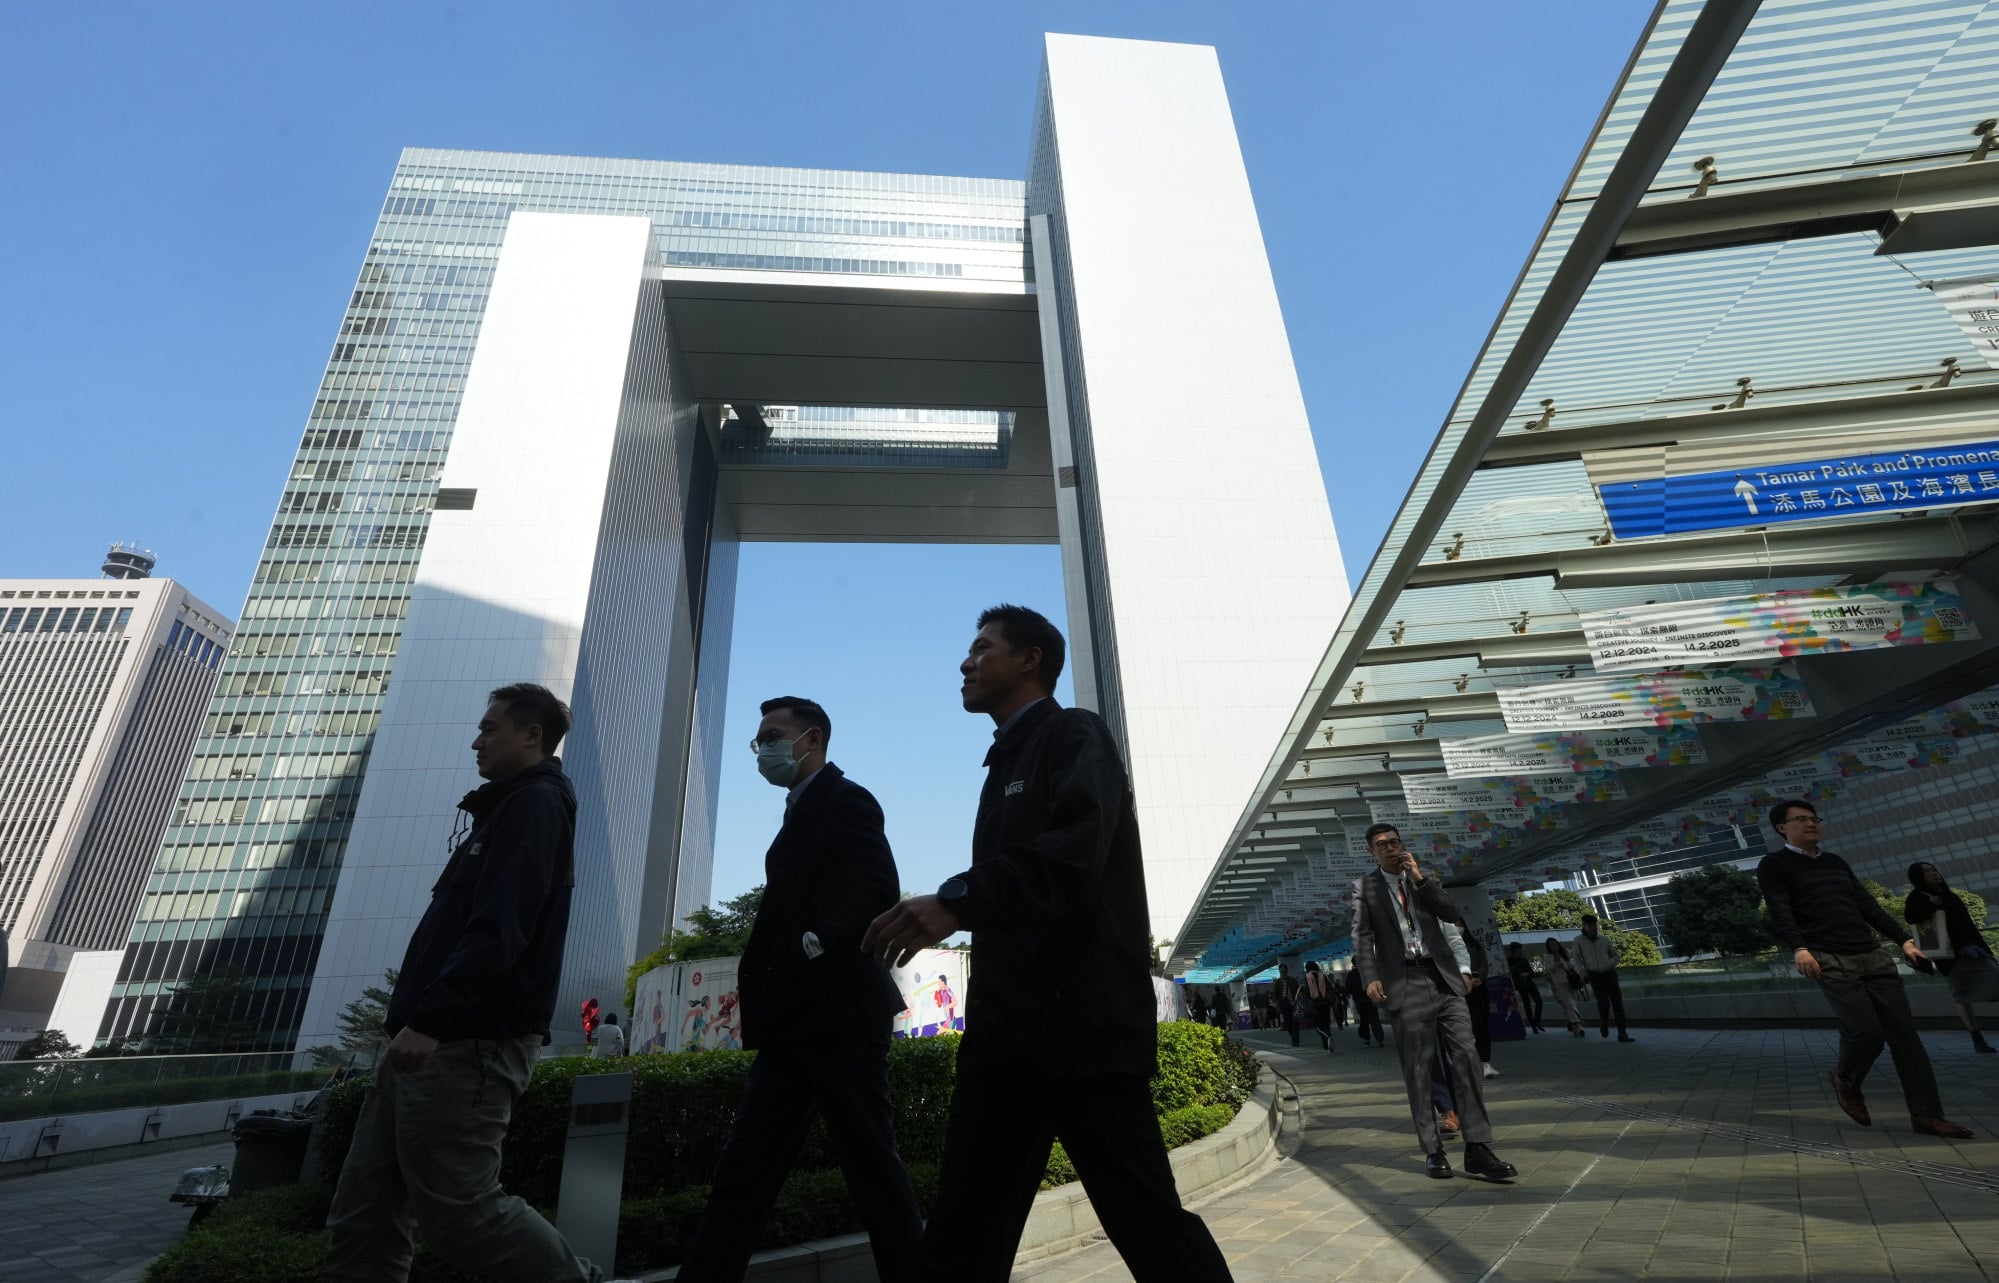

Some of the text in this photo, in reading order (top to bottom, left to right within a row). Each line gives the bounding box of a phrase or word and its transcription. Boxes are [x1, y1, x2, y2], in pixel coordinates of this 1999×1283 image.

[1756, 450, 1999, 486] Tamar Park and Promena
[1769, 470, 1999, 514] 添馬公園及海濱長
[1597, 639, 1629, 647] CREATIVE
[1664, 633, 1696, 641] INFINITE
[1696, 629, 1736, 639] DISCOVERY
[1600, 646, 1658, 659] 12.12.2024
[1684, 639, 1741, 652] 14.2.2025
[1511, 710, 1625, 723] 12.12.2024 14.2.2025
